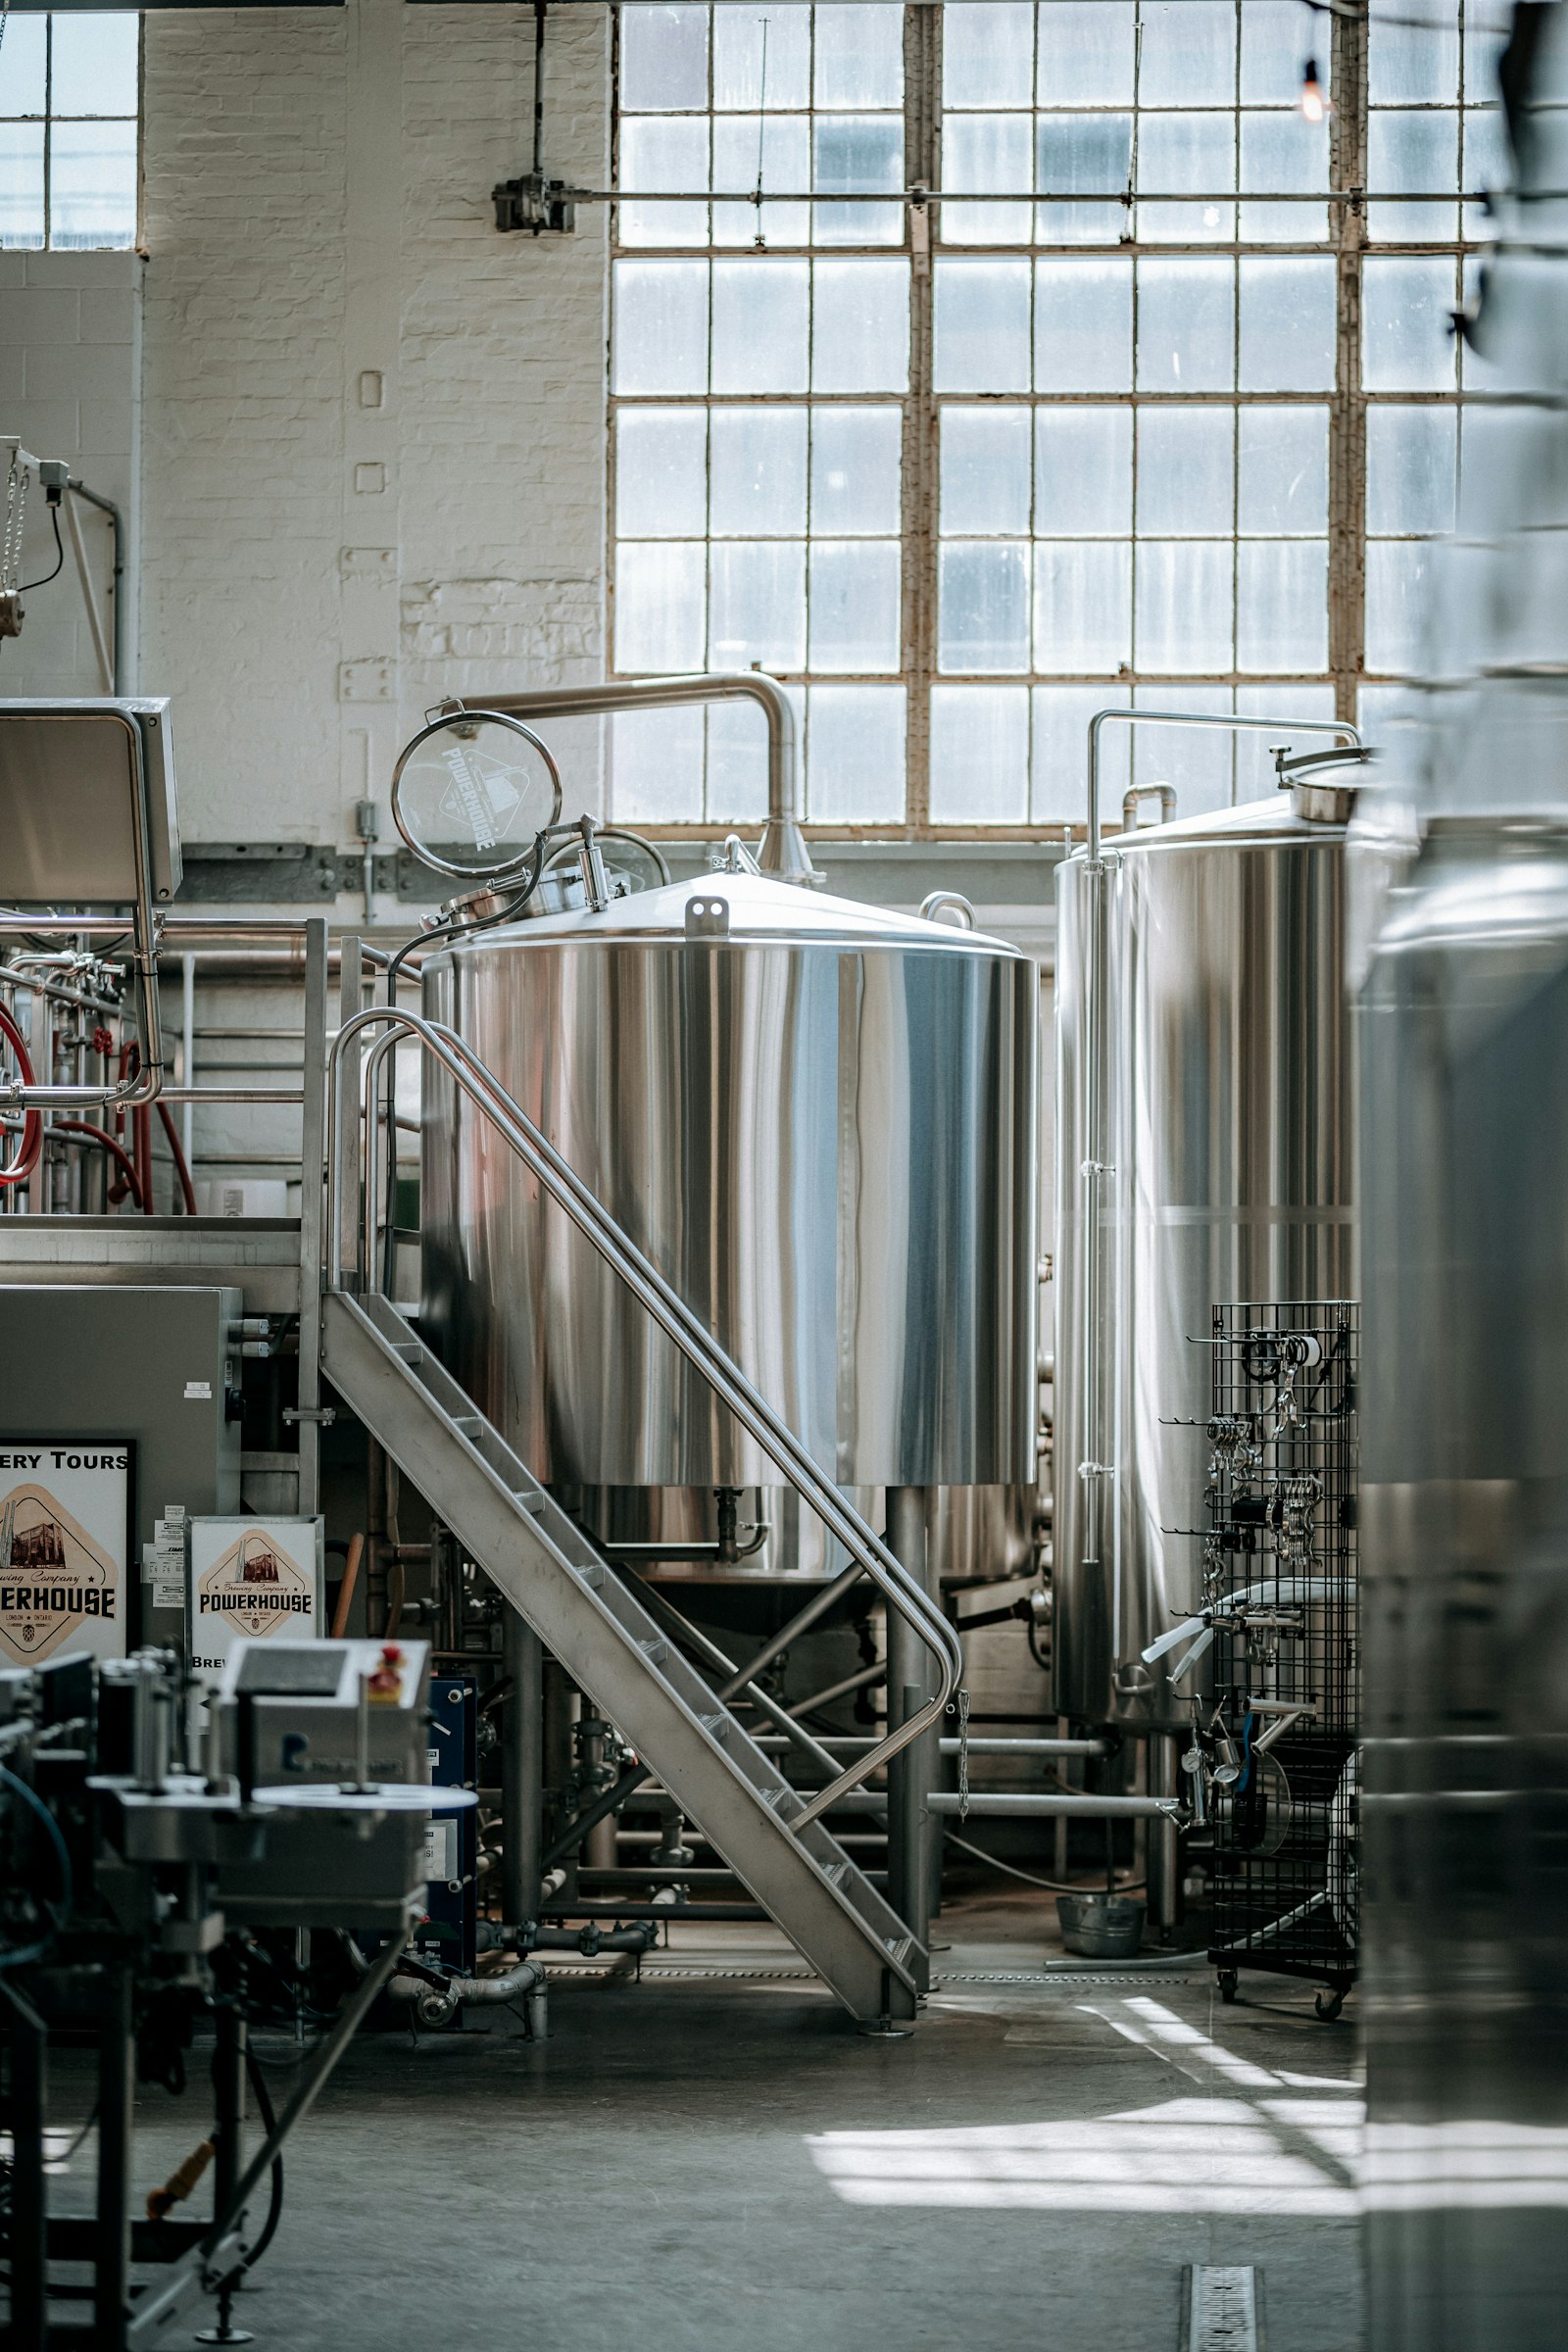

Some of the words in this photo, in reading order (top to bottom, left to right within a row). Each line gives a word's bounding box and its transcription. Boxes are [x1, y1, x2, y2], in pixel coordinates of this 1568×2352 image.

[441, 747, 496, 852] POWERHOUSE
[30, 1570, 80, 1586] Company
[223, 1583, 253, 1593] Brewing
[257, 1584, 289, 1593] Company
[1, 1587, 115, 1619] ERHOUSE
[200, 1594, 312, 1615] POWERHOUSE
